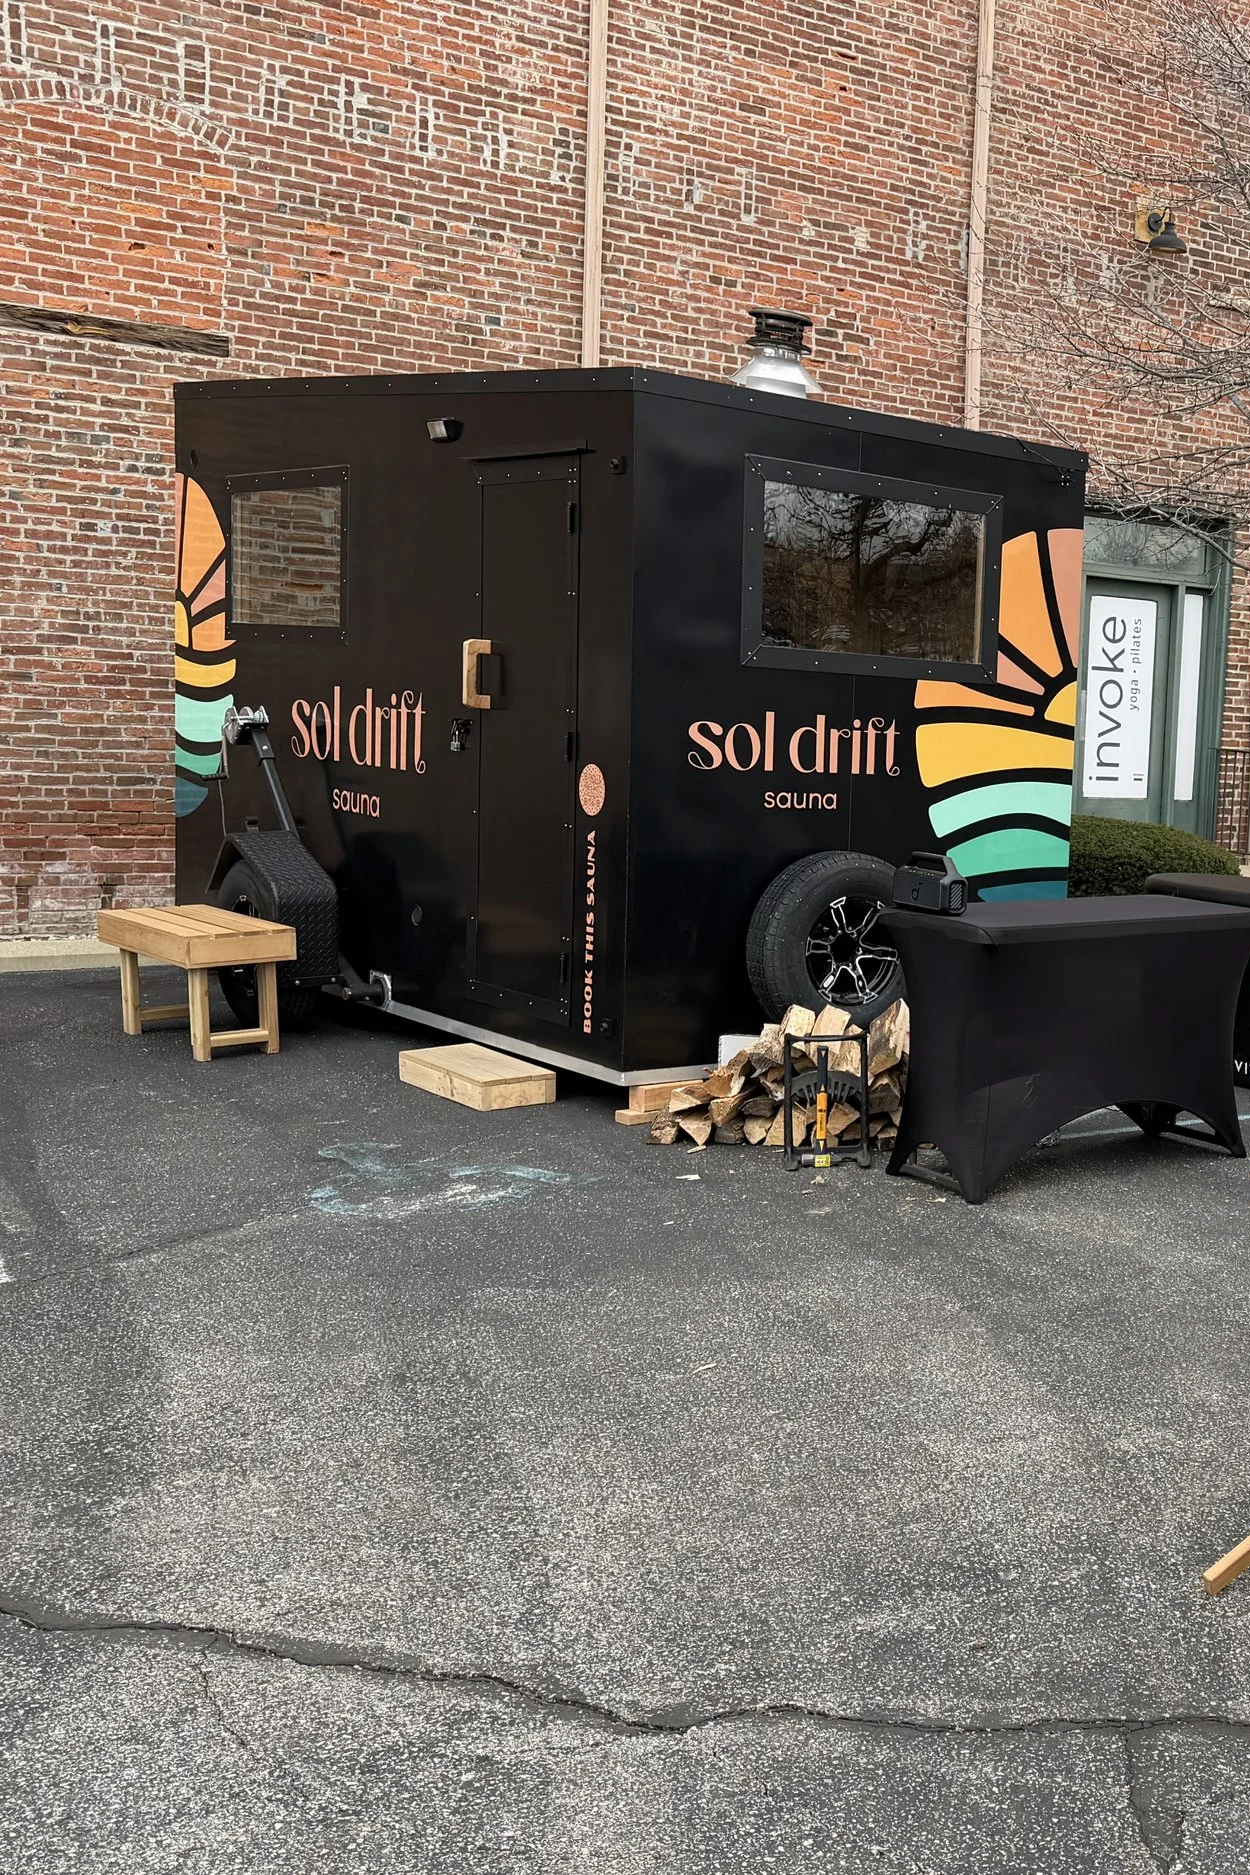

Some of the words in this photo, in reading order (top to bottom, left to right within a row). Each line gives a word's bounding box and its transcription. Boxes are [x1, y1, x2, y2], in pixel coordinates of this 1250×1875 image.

[1130, 618, 1142, 664] pilates
[1088, 616, 1127, 782] invoke
[1129, 679, 1141, 711] yoga
[291, 685, 341, 762] sol
[348, 687, 427, 774] drift
[687, 711, 775, 772] sol
[788, 714, 901, 776] drift
[332, 788, 380, 818] sauna
[764, 791, 838, 810] sauna
[586, 830, 596, 906] SAUNA
[584, 911, 595, 963] THIS
[583, 969, 593, 1034] BOOK
